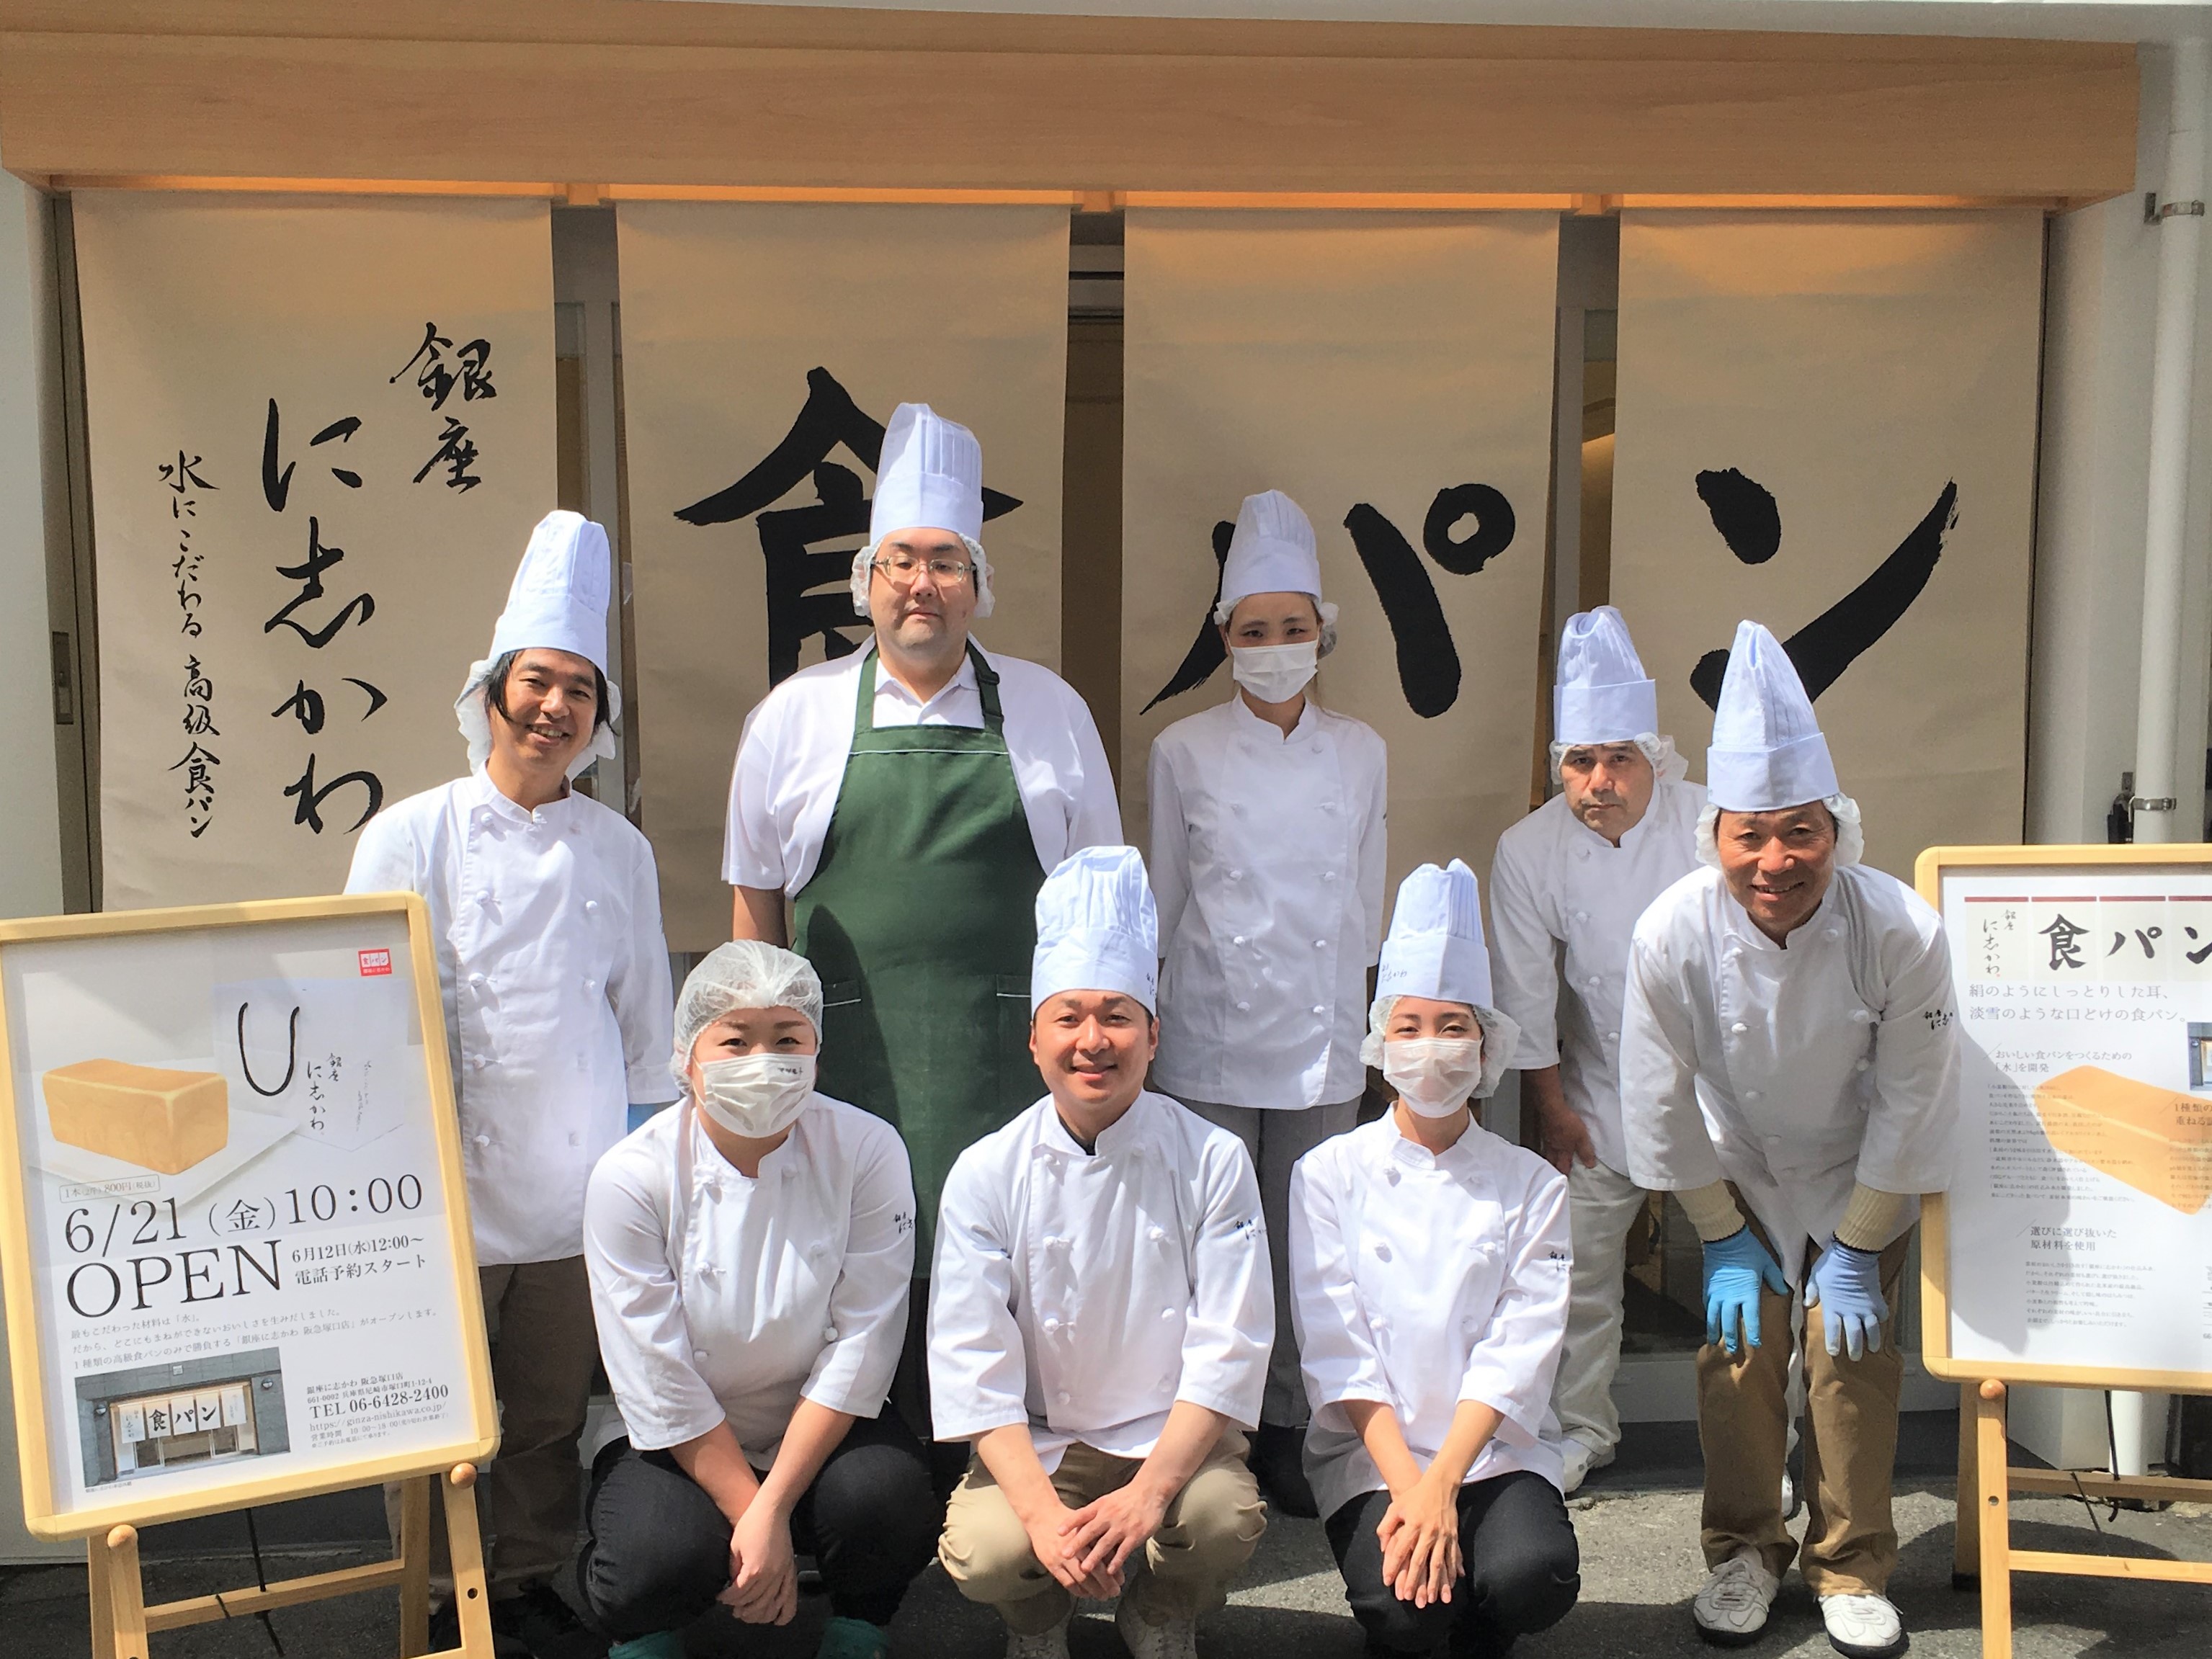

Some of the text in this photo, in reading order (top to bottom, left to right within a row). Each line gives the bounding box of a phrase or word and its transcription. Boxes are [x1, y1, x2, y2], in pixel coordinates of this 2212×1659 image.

[391, 321, 497, 493] 銀座
[263, 398, 388, 834] に志かわ
[159, 450, 221, 839] 水にこだわる 高級食パン
[1968, 984, 2169, 1000] 絹のようにしっとりした耳、
[1969, 1006, 2188, 1022] 淡雪のような口どけの食パン。
[1995, 1049, 2132, 1061] おいしい食パンをつくるための
[1996, 1063, 2050, 1073] 「水」を開発
[66, 1173, 423, 1257] 6/21 (金) 10:00
[2030, 1226, 2117, 1238] 選びに選び抜いた
[2030, 1239, 2096, 1251] 原材料を使用
[66, 1239, 282, 1318] OPEN
[295, 1253, 426, 1285] 電話予約スタート
[71, 1313, 200, 1339] 最もこだわった材料は「水」。
[307, 1379, 357, 1395] 銀座に志かわ
[309, 1384, 449, 1418] TEL 06-6428-2400
[148, 1406, 217, 1432] 食パン
[310, 1400, 447, 1431] https://ginza-nishikawa.co.jp/
